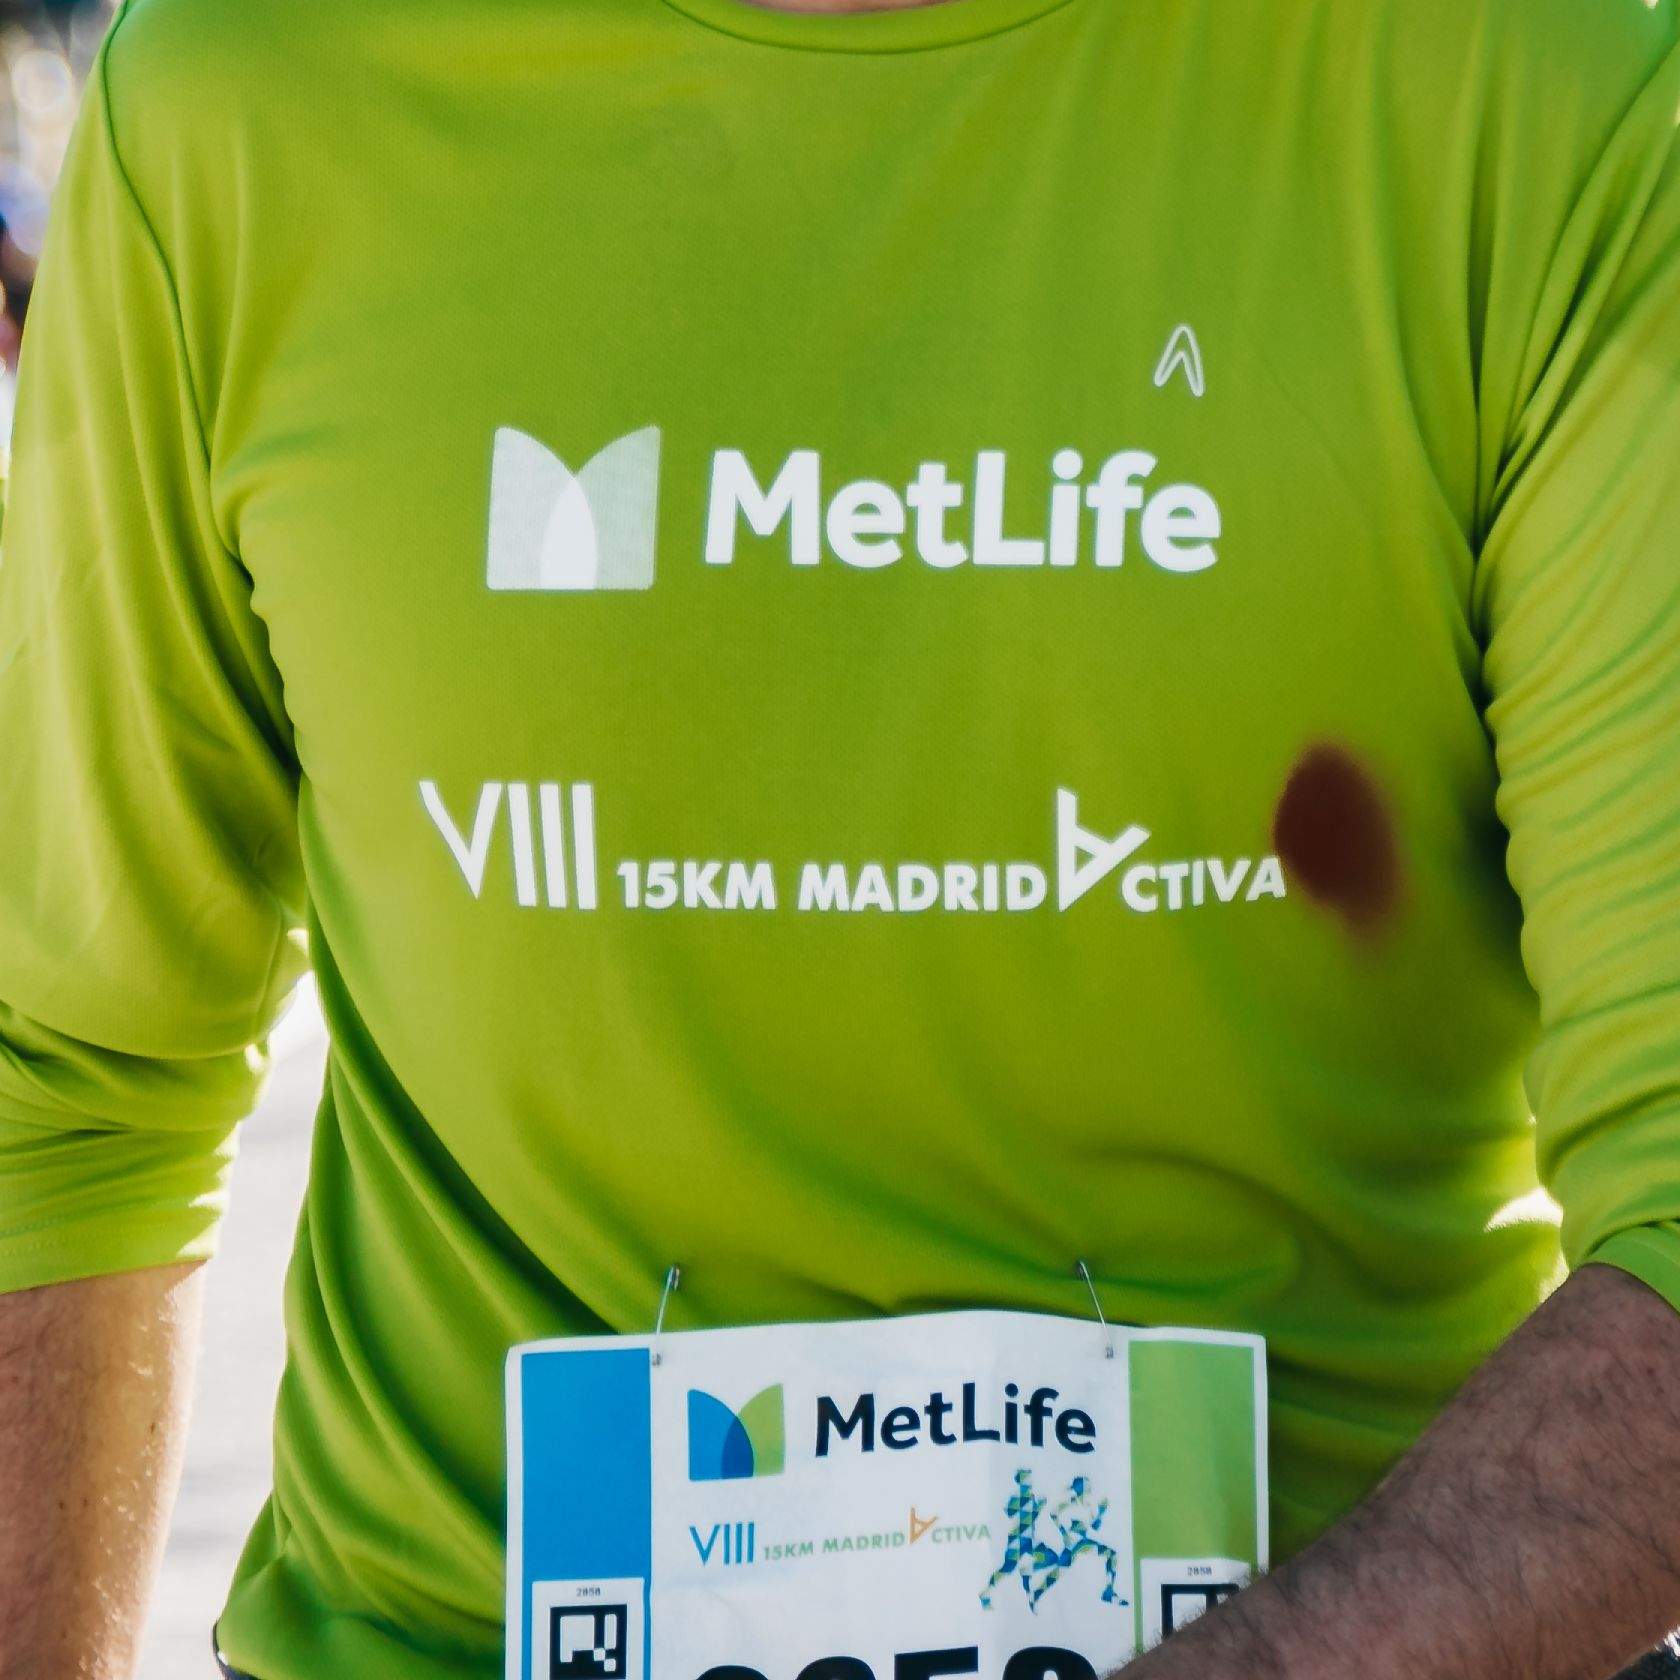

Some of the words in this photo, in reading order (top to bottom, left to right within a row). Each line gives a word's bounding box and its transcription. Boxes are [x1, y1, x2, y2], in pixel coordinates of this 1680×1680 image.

[705, 447, 1222, 572] MetLife
[418, 779, 598, 911] VIII
[617, 861, 778, 910] 15KM
[797, 861, 1047, 913] MADRID
[814, 1382, 1096, 1458] MetLife
[688, 1521, 755, 1566] VIII
[763, 1541, 814, 1561] 15KM
[822, 1531, 905, 1553] MADRID
